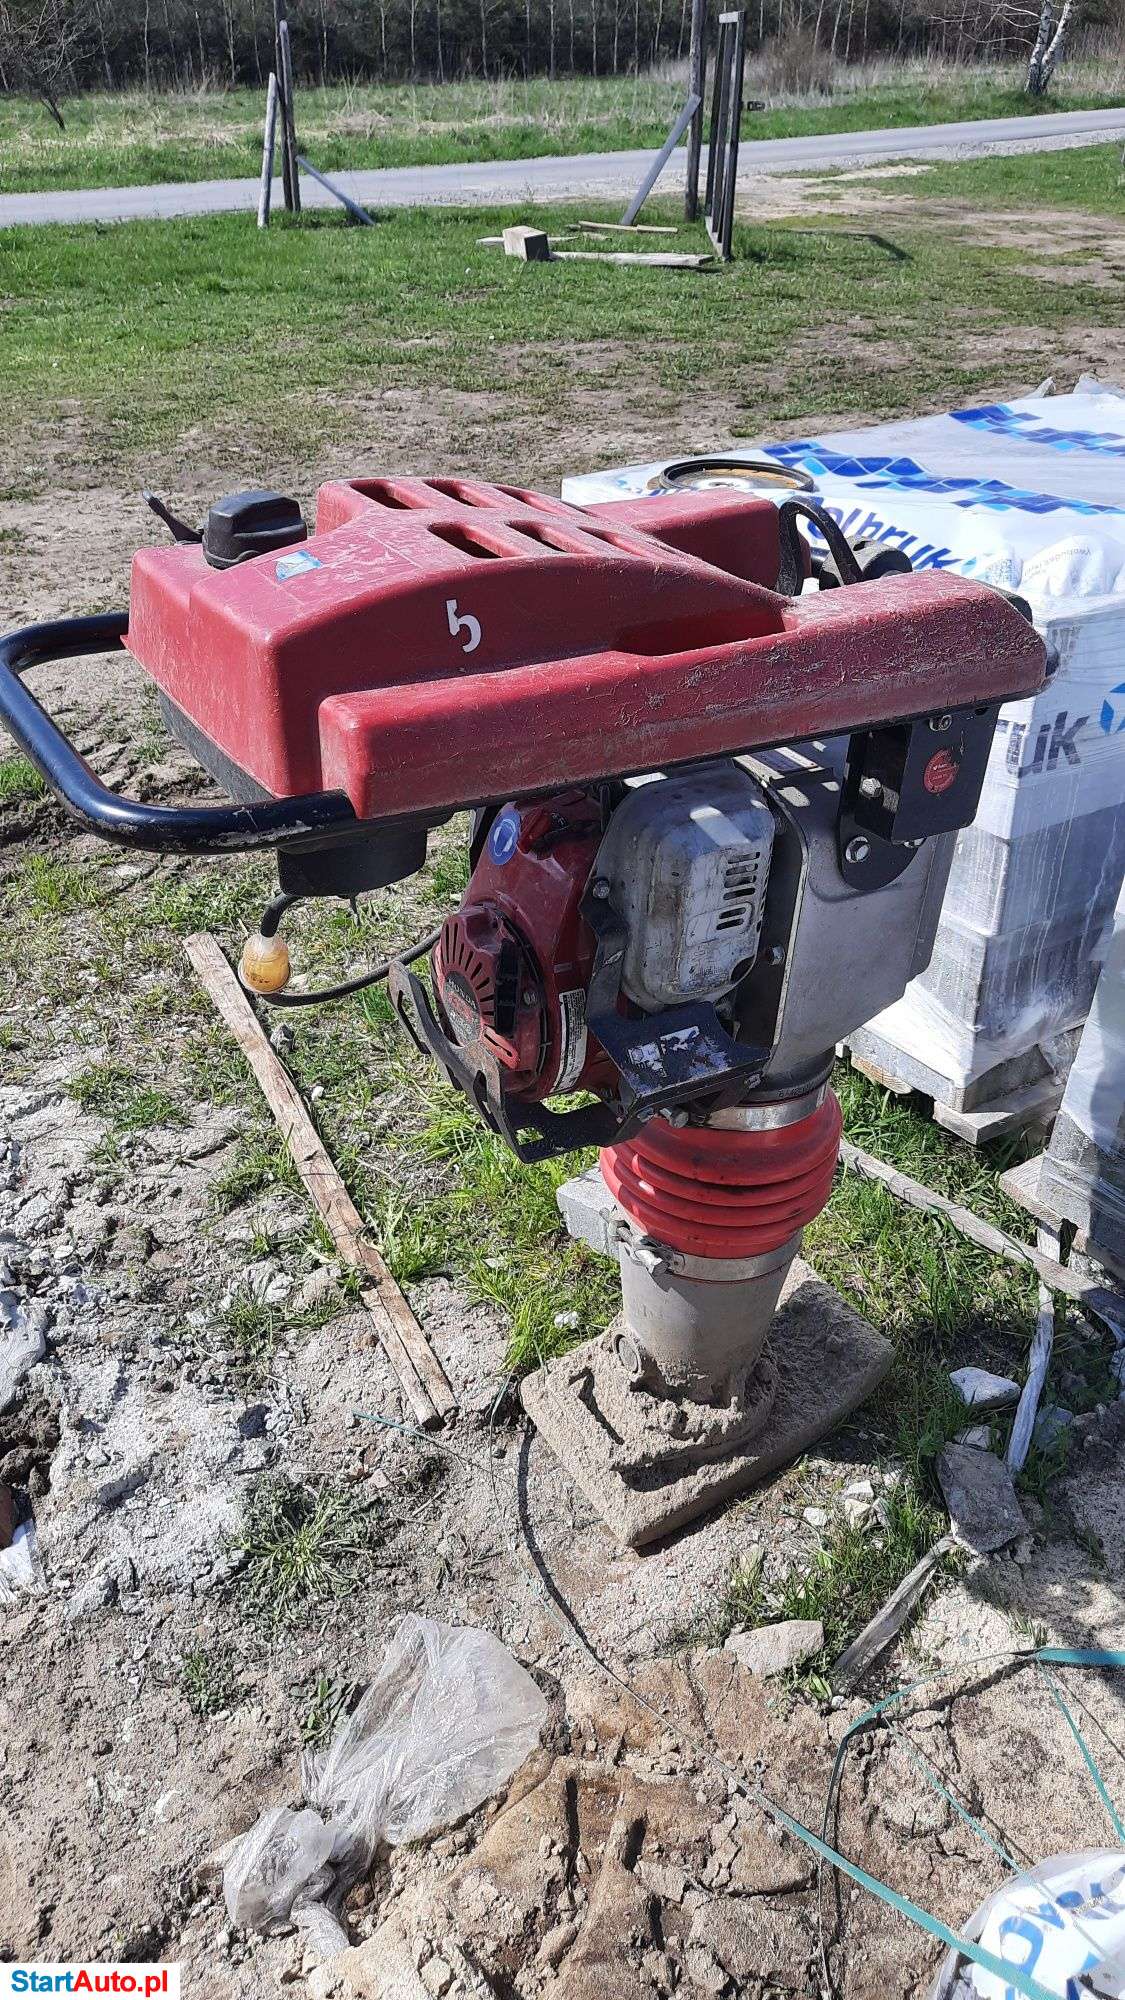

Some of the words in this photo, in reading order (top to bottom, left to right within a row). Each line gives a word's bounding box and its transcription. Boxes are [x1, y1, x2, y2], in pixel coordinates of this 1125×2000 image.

[807, 497, 963, 570] olbruk
[446, 599, 482, 653] 5
[996, 710, 1090, 778] uk
